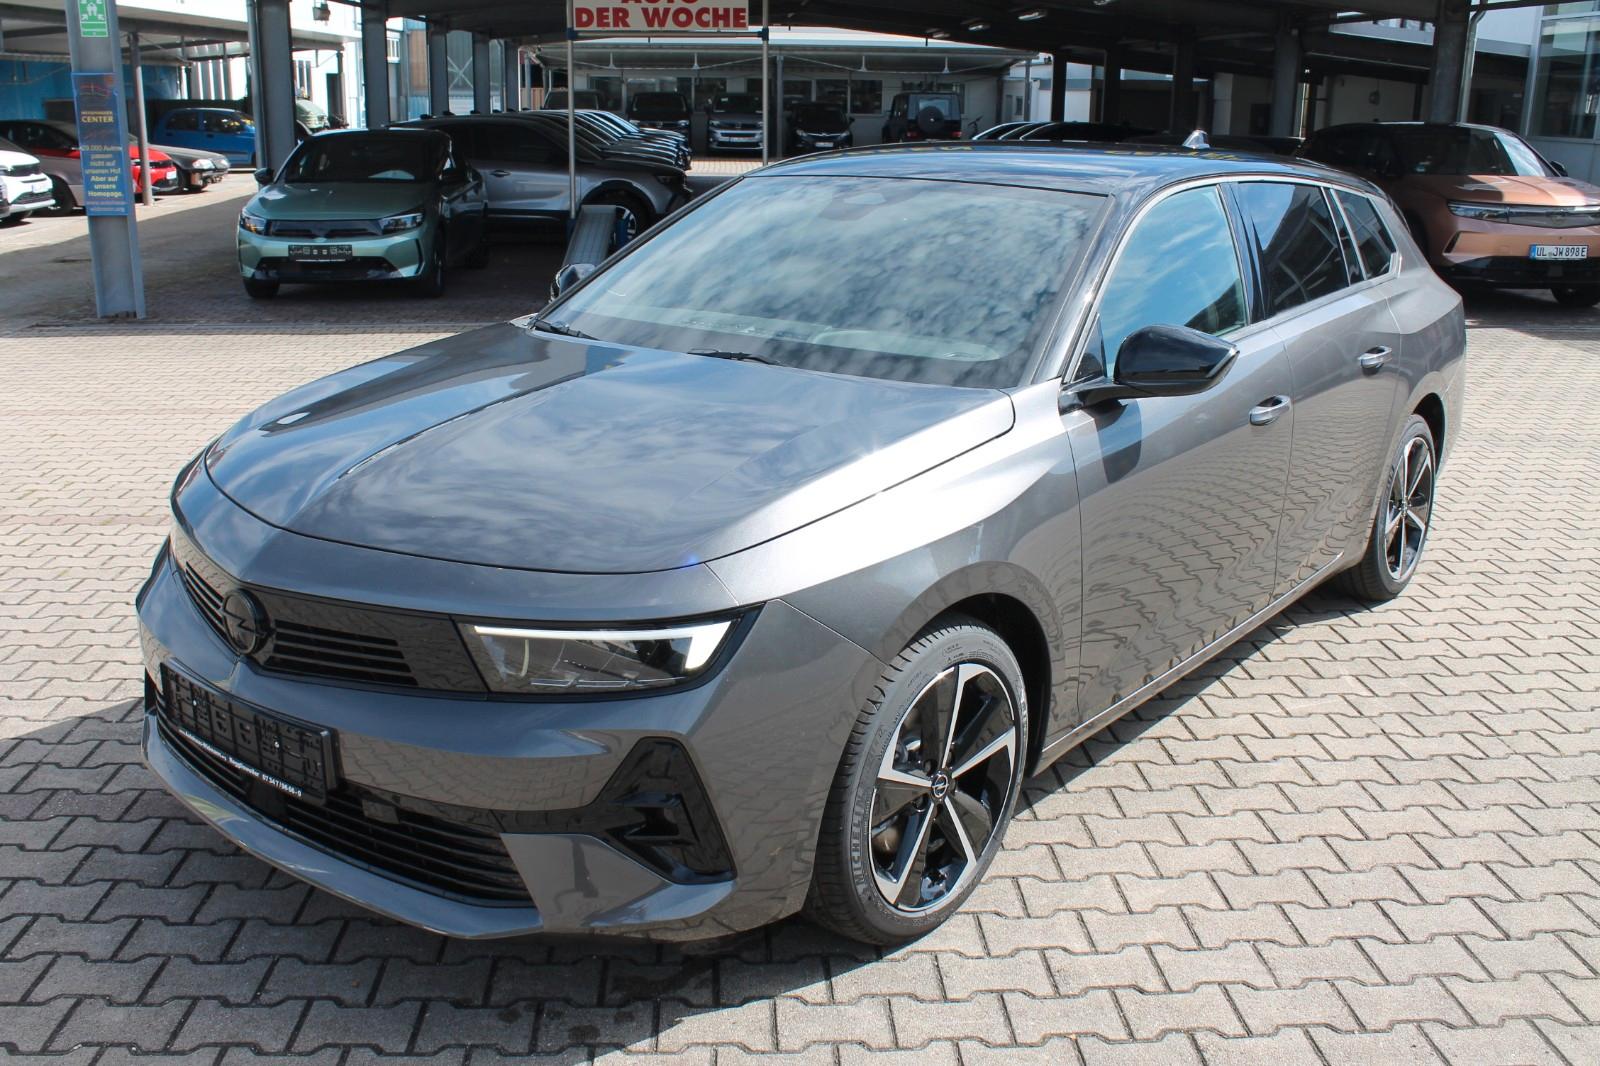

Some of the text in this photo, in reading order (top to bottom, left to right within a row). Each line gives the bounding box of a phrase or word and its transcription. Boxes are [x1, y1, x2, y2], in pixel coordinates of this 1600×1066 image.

[575, 7, 747, 28] DER WOCHE
[81, 115, 114, 123] CENTER
[1536, 247, 1547, 257] UL
